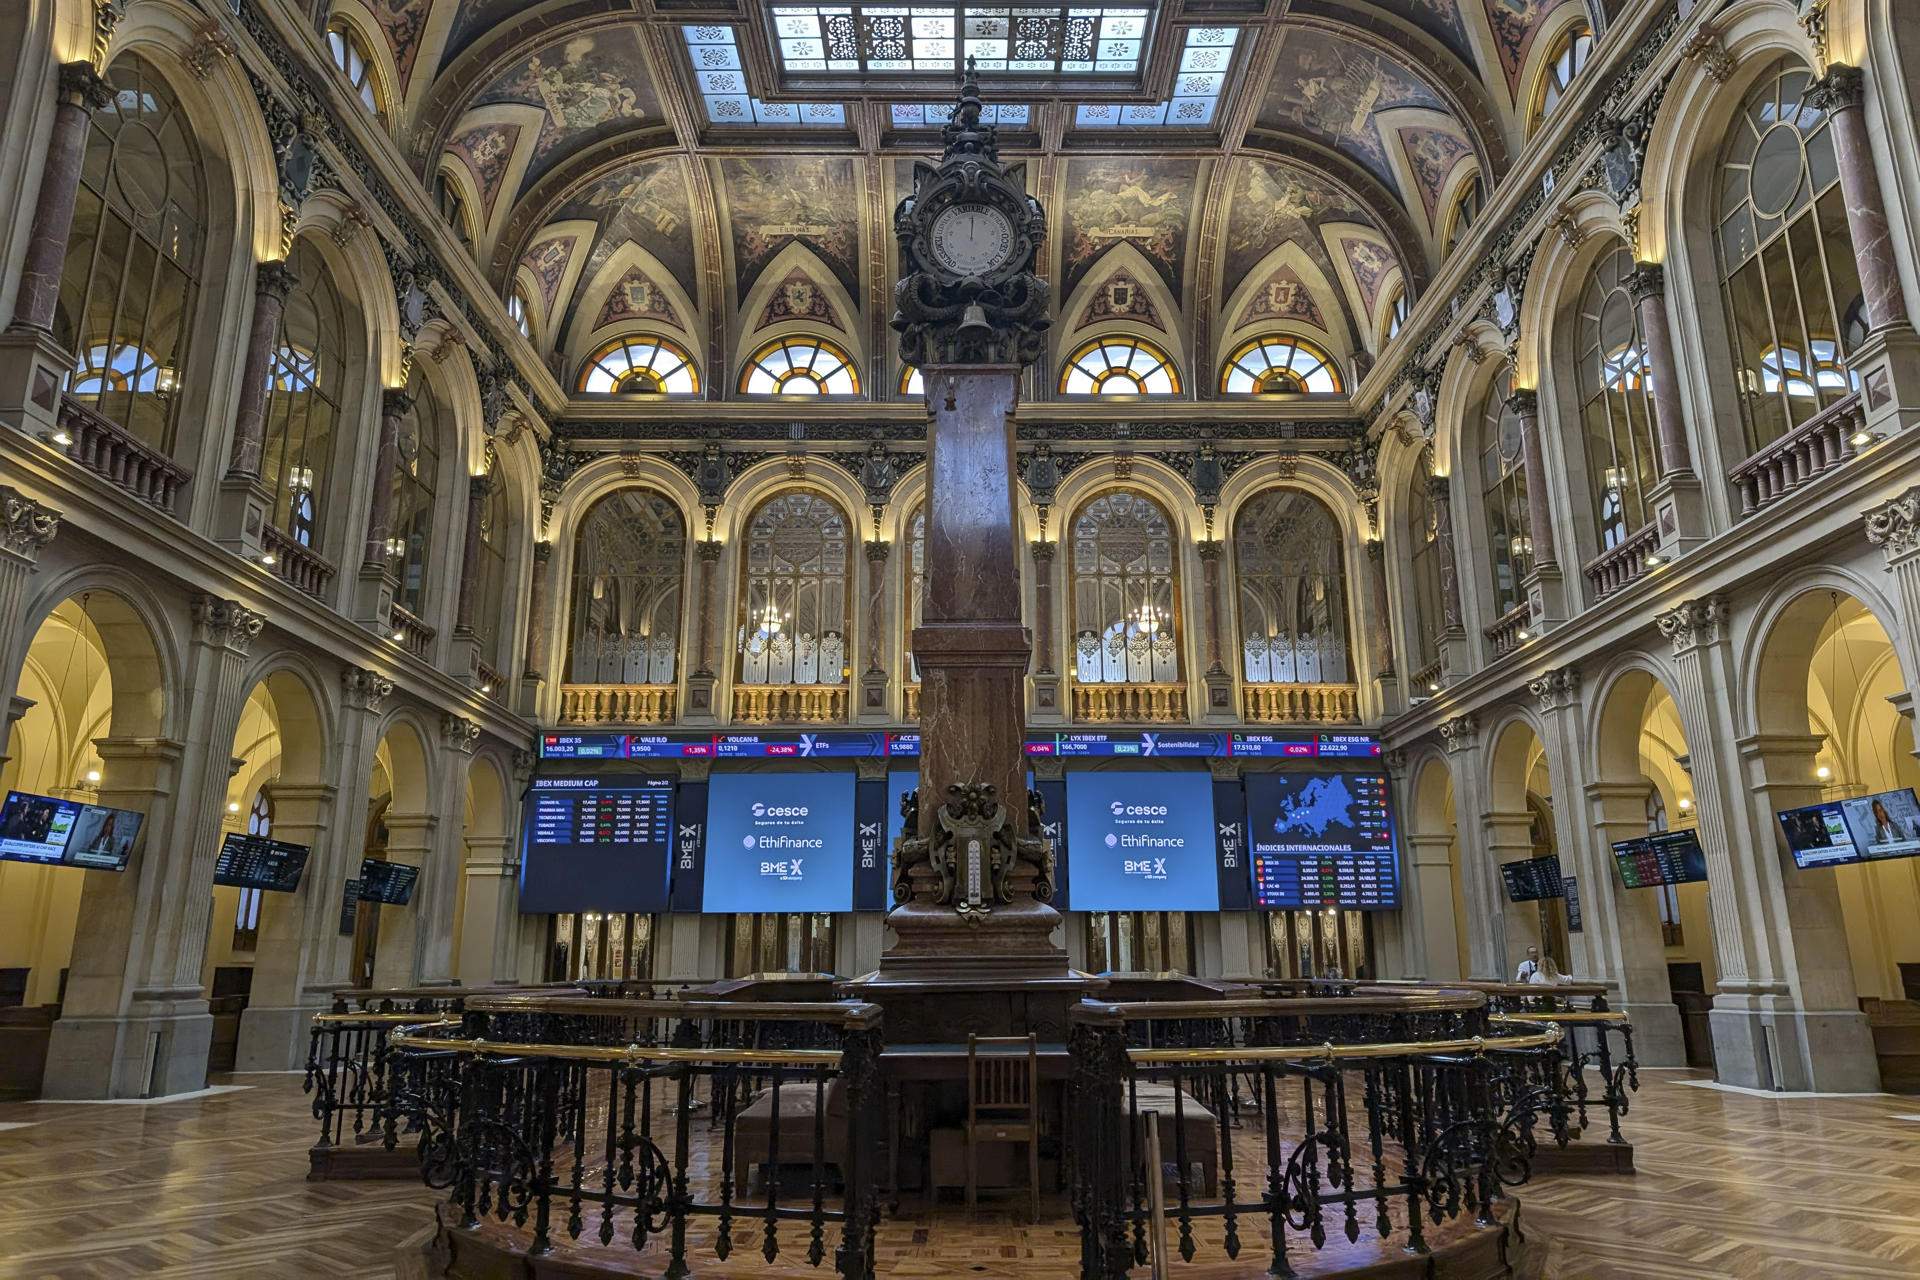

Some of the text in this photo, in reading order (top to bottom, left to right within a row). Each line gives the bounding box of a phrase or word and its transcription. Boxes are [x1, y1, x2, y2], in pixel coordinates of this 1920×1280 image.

[952, 205, 990, 216] VARIABLE
[934, 236, 956, 268] TEMPESTAD
[987, 234, 1009, 268] MUY SECO
[767, 807, 809, 817] cesce
[1126, 806, 1168, 815] cesce
[760, 836, 823, 848] EthiFinance
[1121, 834, 1184, 847] EthiFinance
[1256, 843, 1285, 851] ÍNDICES
[680, 840, 693, 869] BME
[862, 839, 873, 868] BME
[1223, 839, 1235, 868] BME
[760, 862, 788, 873] BME
[1124, 860, 1151, 872] BME
